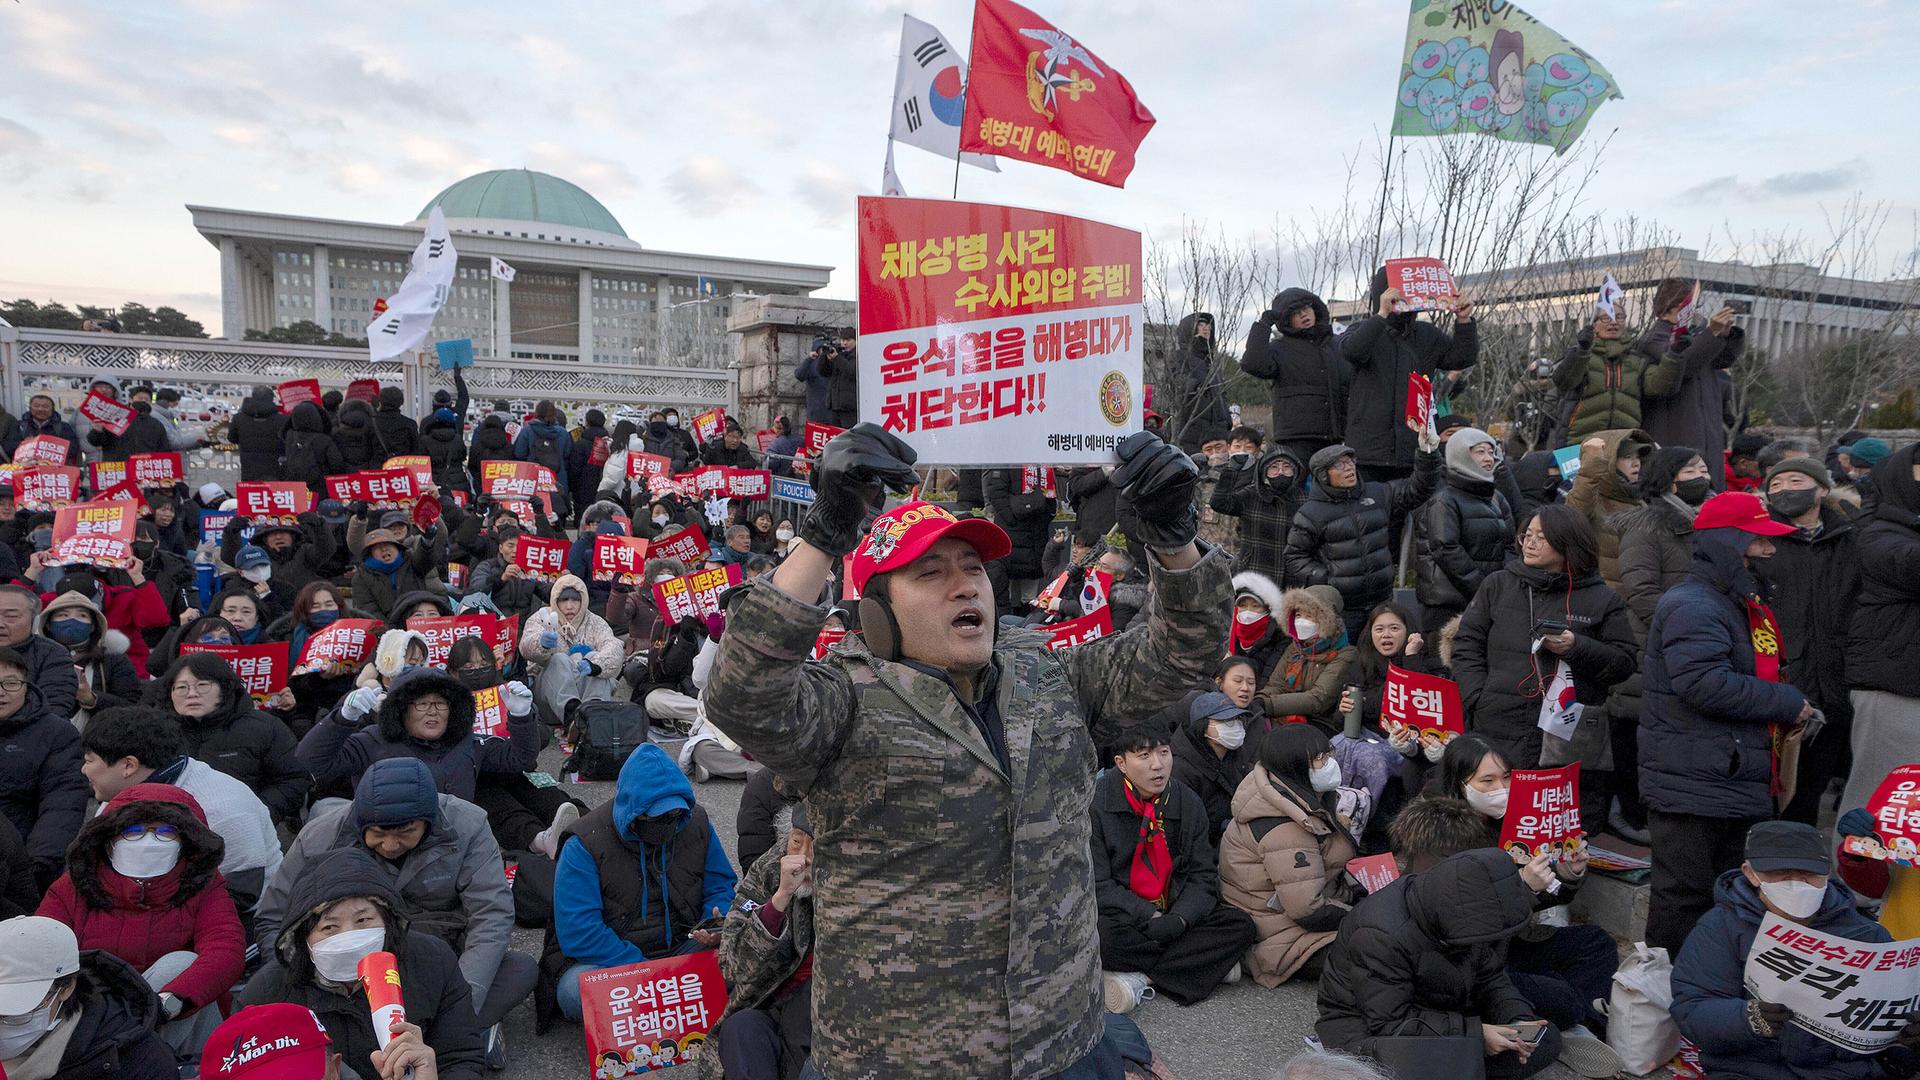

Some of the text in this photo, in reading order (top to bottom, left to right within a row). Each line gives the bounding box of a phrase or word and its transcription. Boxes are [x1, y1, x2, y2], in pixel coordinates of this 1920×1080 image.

[979, 117, 1034, 154] 해병대
[1073, 142, 1116, 178] 연대
[880, 229, 1055, 280] 채상병 사건
[1401, 266, 1449, 281] 윤석열을
[954, 264, 1131, 313] 수사외압 주범!
[1402, 281, 1452, 298] 탄핵하라
[881, 315, 1132, 386] 윤석열을 해병대가
[881, 372, 1047, 434] 처단한다!!
[813, 431, 837, 451] 탄
[1048, 434, 1083, 451] 해병대
[1085, 434, 1115, 452] 예비역
[135, 459, 174, 470] 윤석열을
[485, 463, 517, 480] 탄핵
[633, 458, 662, 474] 탄핵
[23, 473, 71, 489] 윤석열을
[369, 475, 411, 499] 탄핵
[492, 478, 537, 496] 윤석열
[784, 484, 804, 498] POLICE
[23, 487, 71, 501] 탄핵하라
[248, 491, 296, 513] 탄핵
[77, 507, 123, 522] 내란죄
[886, 505, 959, 541] ROK
[526, 546, 564, 570] 탄핵
[600, 545, 634, 571] 탄핵
[655, 535, 696, 558] 윤석열을
[689, 567, 728, 593] 내란죄
[665, 592, 691, 610] 윤석
[312, 628, 366, 648] 윤석열을
[424, 625, 484, 643] 윤석열을
[306, 644, 365, 662] 탄핵하라
[1388, 680, 1444, 726] 탄핵
[1764, 924, 1878, 971] 내란수괴
[1754, 947, 1861, 1000] 즉각
[608, 973, 703, 1016] 윤석열을
[612, 1001, 709, 1047] 탄핵하라
[1824, 994, 1920, 1032] 체포
[238, 1035, 300, 1066] Mar. Div.
